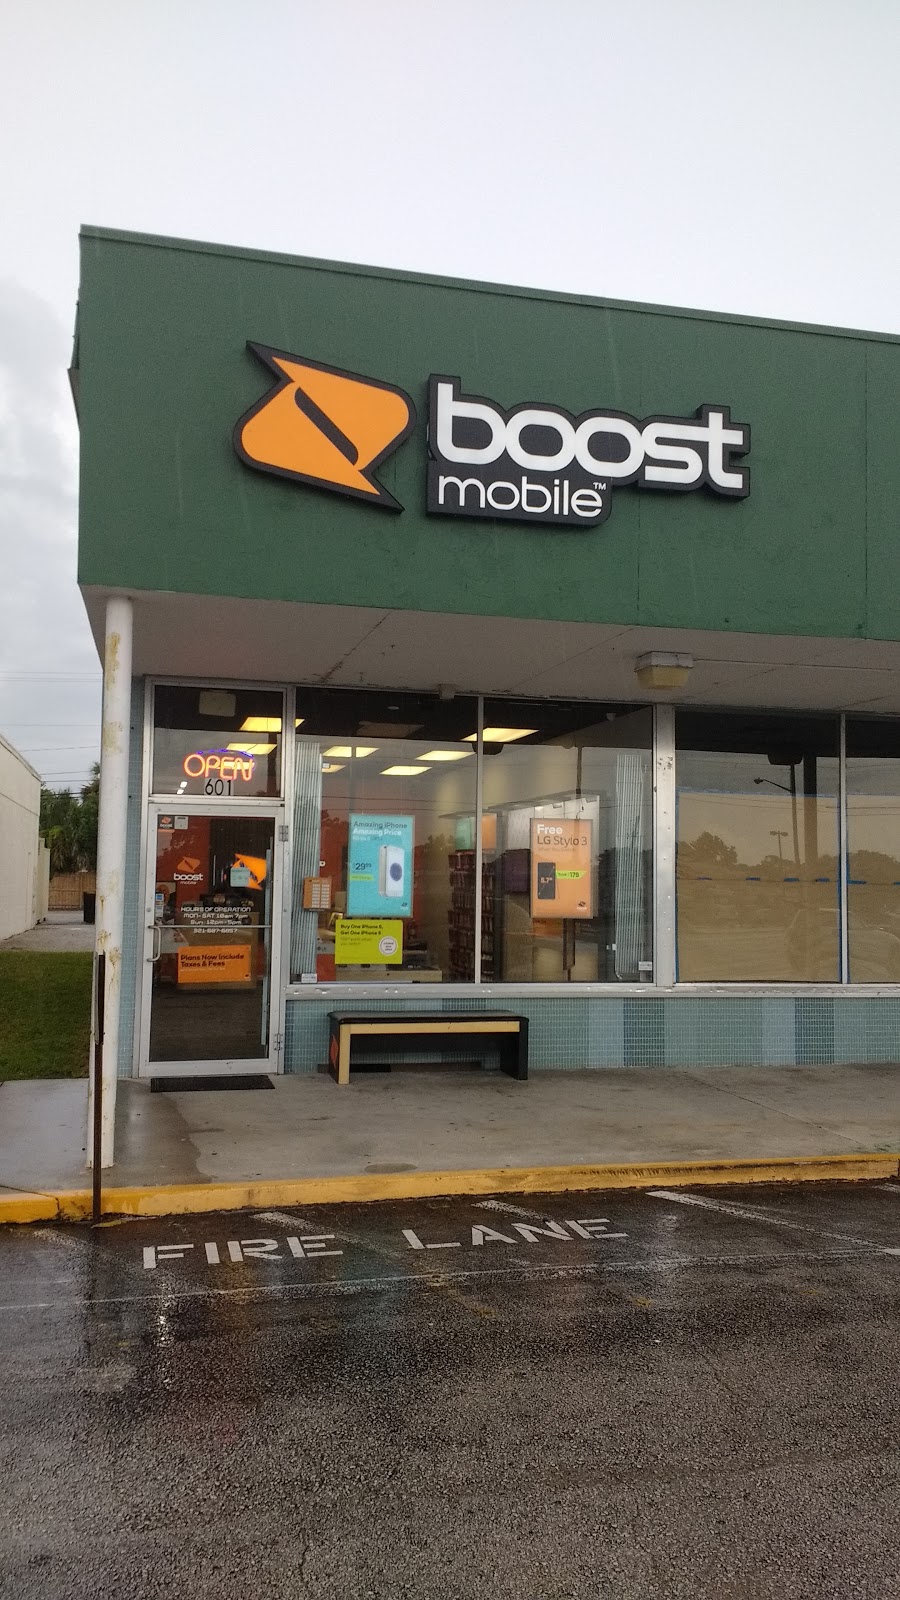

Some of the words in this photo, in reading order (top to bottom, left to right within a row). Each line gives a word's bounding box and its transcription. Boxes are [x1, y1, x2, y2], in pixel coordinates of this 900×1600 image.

[437, 382, 743, 489] boost
[438, 475, 602, 518] mobile
[184, 754, 254, 781] OPEN
[205, 779, 232, 796] 601
[353, 821, 383, 830] Amazing
[384, 821, 408, 829] iPhone
[536, 824, 563, 835] Free
[352, 828, 383, 837] Amazing
[537, 836, 551, 845] LG
[553, 836, 580, 848] Stylo
[581, 836, 588, 846] 3
[173, 872, 204, 881] boost
[218, 952, 244, 960] Include
[143, 1234, 343, 1269] FIRE
[401, 1218, 629, 1250] LANE
